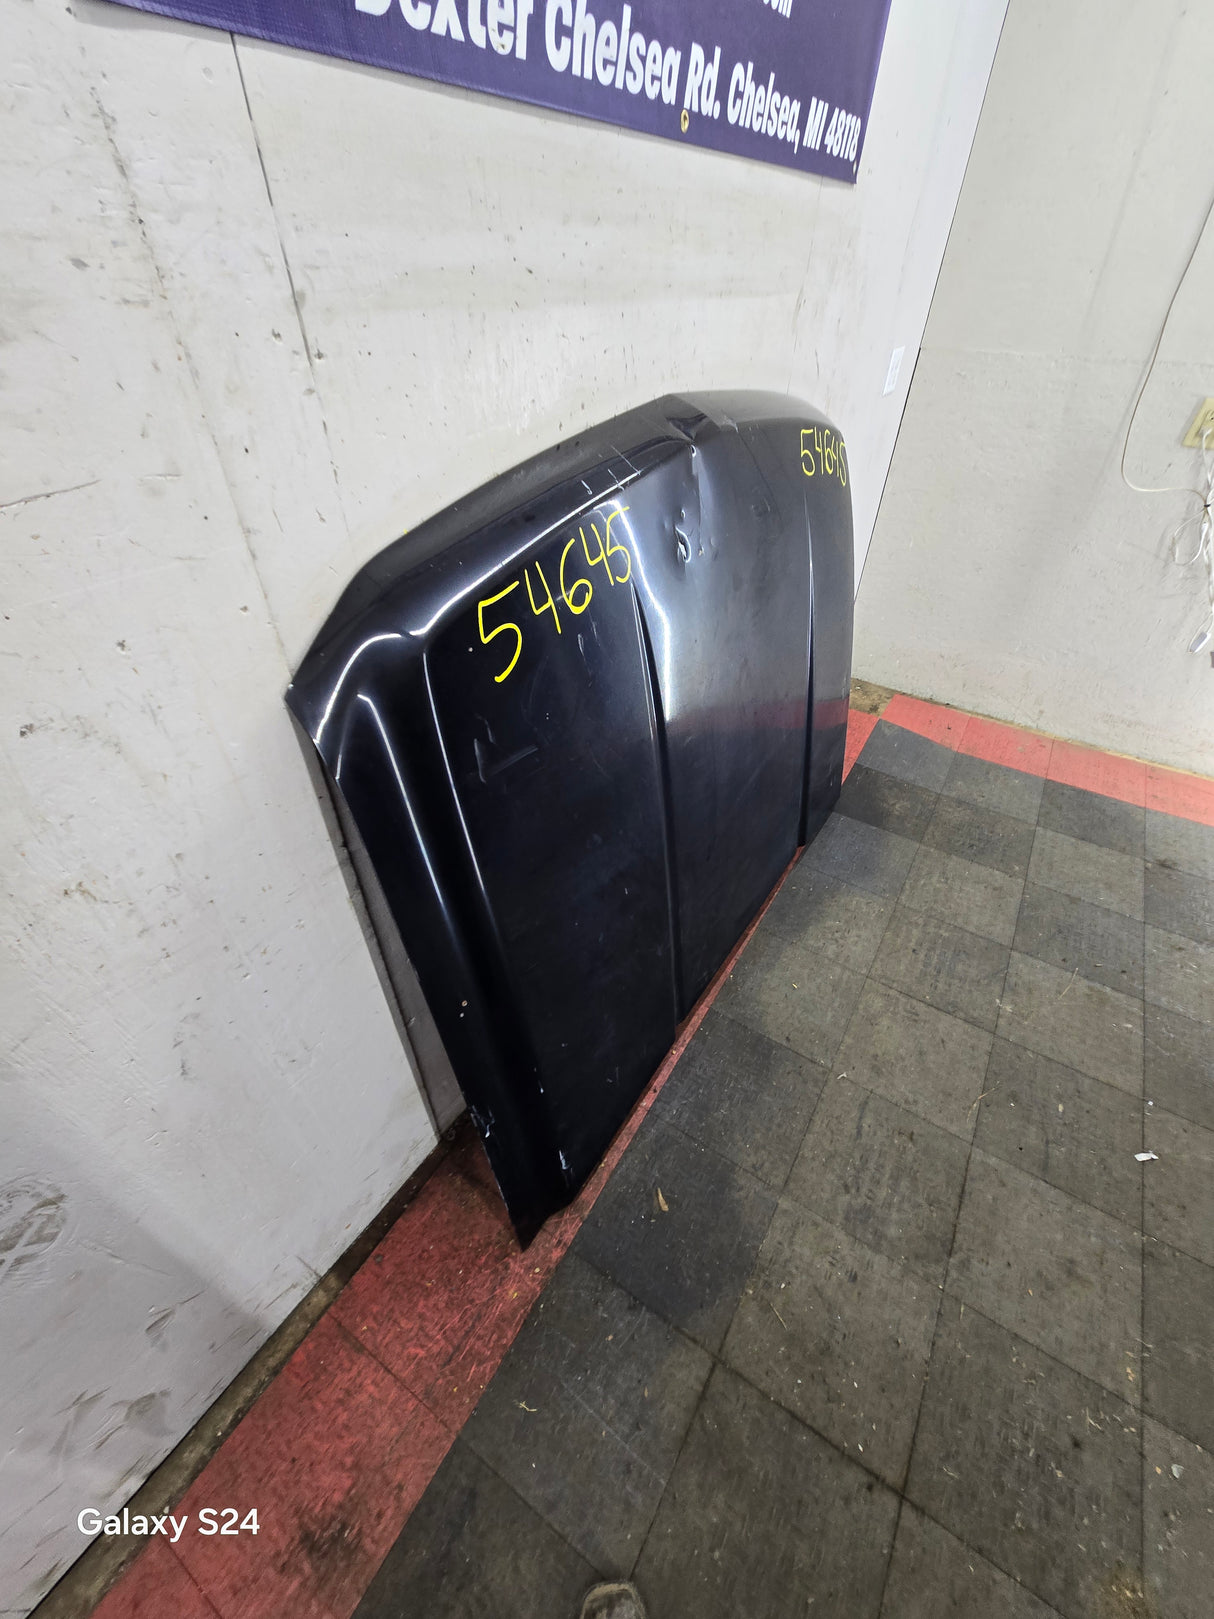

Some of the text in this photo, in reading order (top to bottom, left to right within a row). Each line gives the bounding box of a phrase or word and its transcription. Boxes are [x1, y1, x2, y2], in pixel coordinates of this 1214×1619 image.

[545, 0, 682, 106] Chelsea
[683, 41, 722, 119] Rd.
[727, 60, 801, 155] Chelsea,
[802, 95, 829, 151] MI
[824, 106, 862, 162] 48118
[800, 426, 847, 487] 54645
[477, 506, 631, 683] 54645
